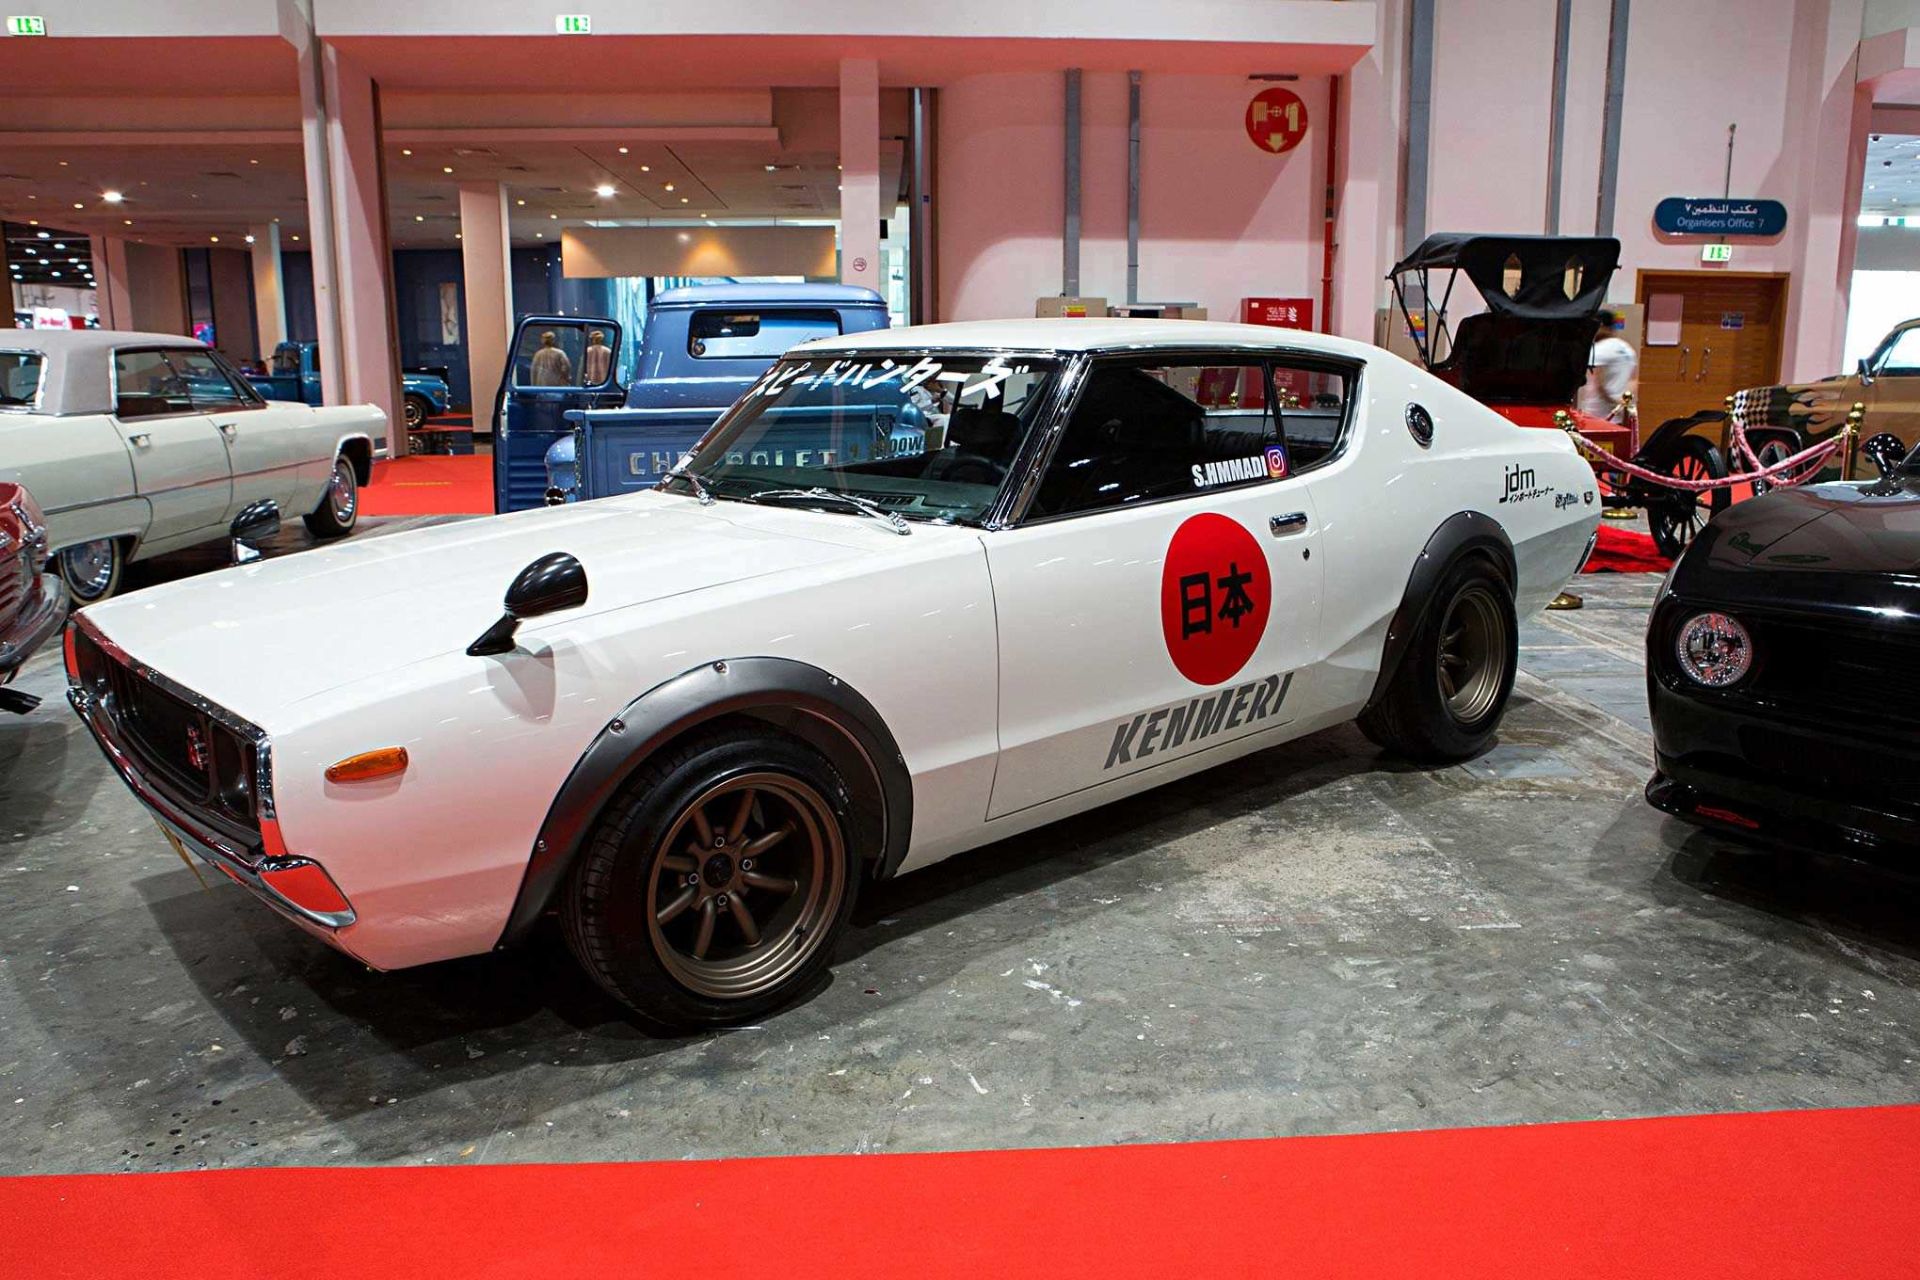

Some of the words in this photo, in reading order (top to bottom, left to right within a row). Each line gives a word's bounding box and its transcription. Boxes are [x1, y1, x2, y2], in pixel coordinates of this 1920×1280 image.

[1677, 217, 1726, 230] Organisers
[1727, 217, 1755, 228] Office
[742, 357, 1030, 402] スピードハンターズ
[1191, 455, 1269, 488] S.HMMADI
[1499, 463, 1535, 504] jdm
[1179, 561, 1255, 641] 日本
[1103, 671, 1295, 770] KENMERI
